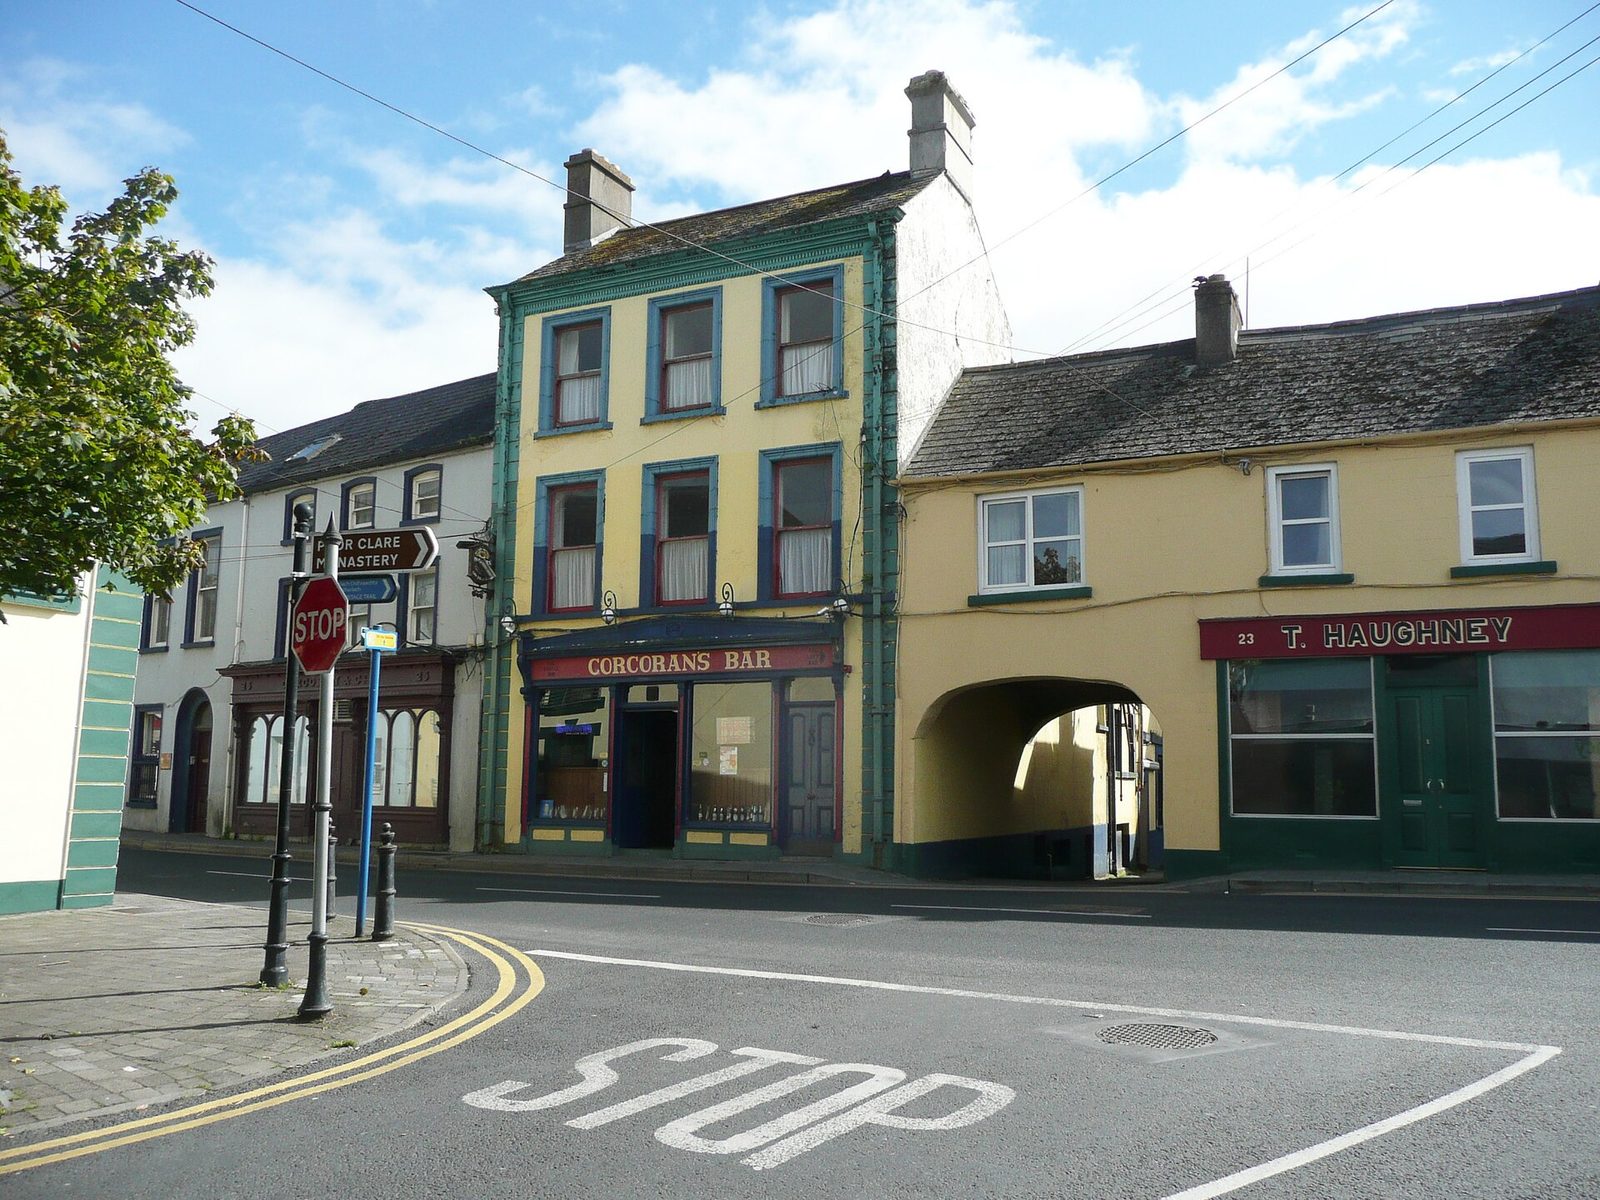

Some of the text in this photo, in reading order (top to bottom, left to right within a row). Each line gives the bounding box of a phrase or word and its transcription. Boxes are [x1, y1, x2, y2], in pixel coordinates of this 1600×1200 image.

[317, 536, 401, 552] POR CLARE
[316, 553, 399, 570] MNASTERY
[295, 608, 345, 643] STOP
[1281, 617, 1512, 649] T. HAUGHNEY
[1238, 633, 1255, 645] 23
[587, 651, 711, 676] CORCORAN'S
[724, 650, 772, 670] BAR
[463, 1037, 1017, 1170] STOP
